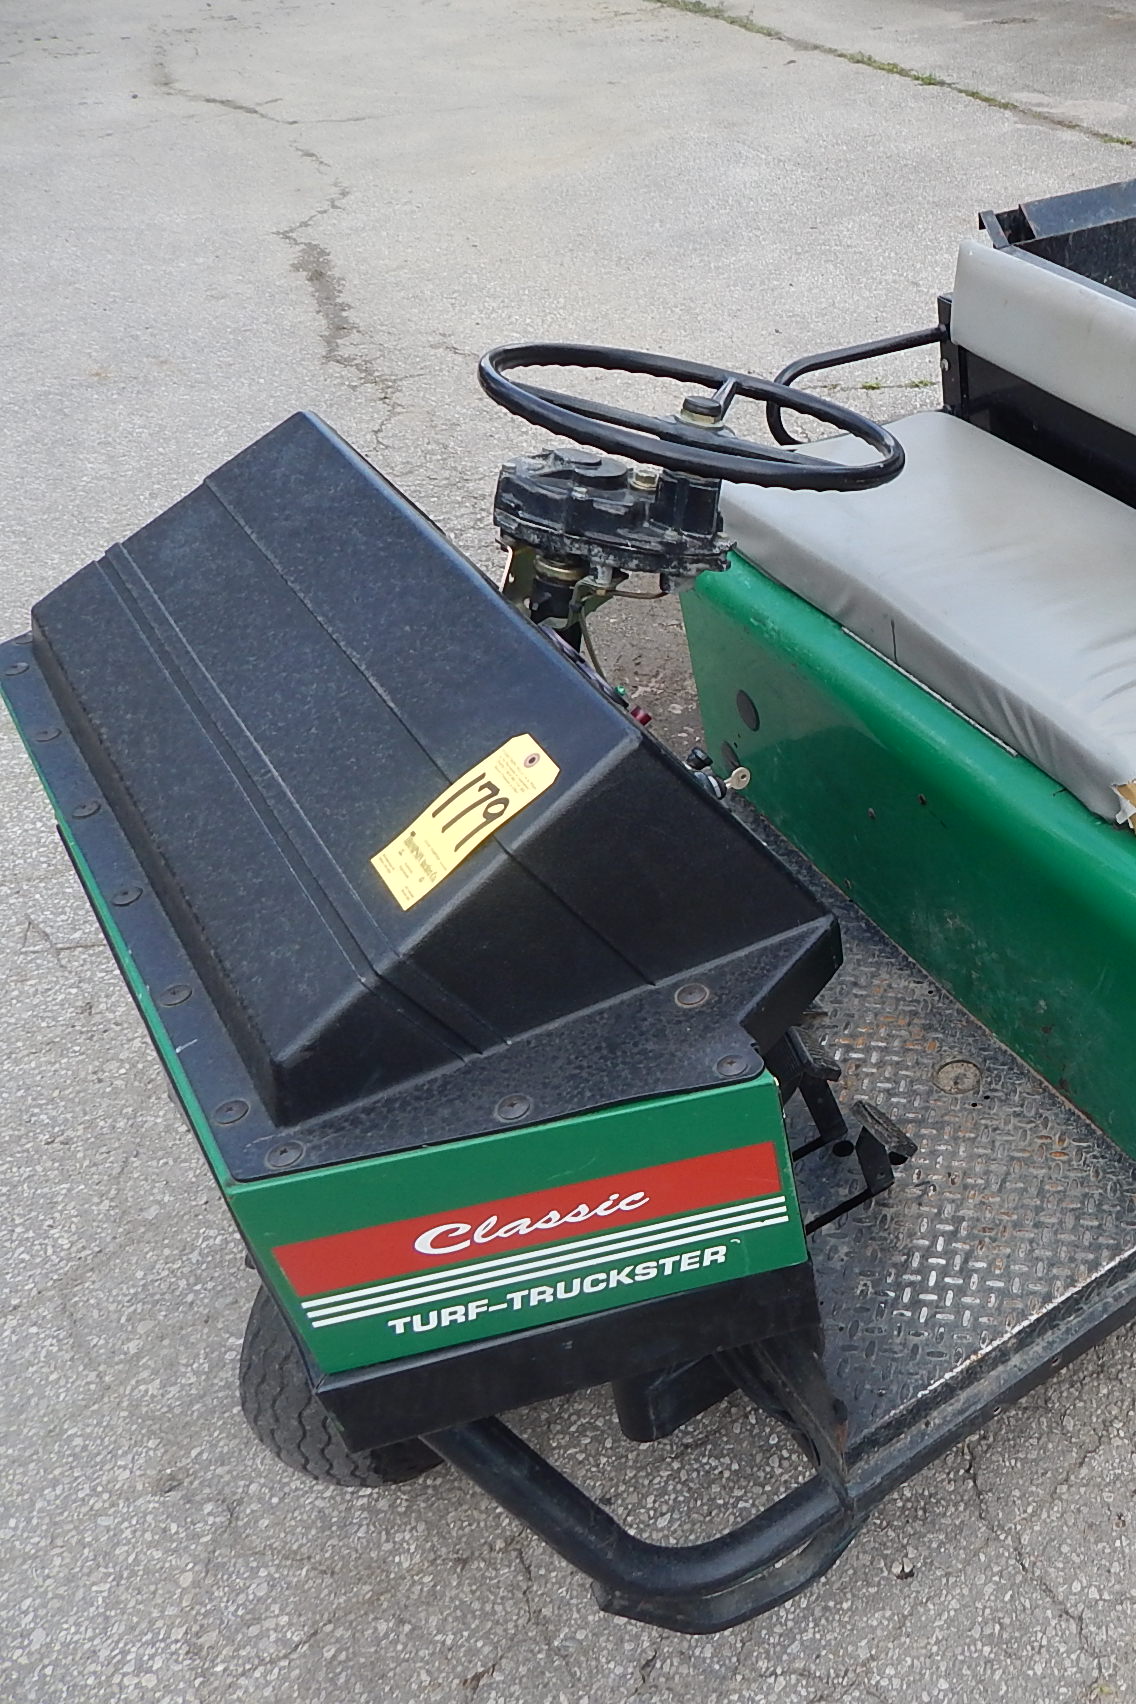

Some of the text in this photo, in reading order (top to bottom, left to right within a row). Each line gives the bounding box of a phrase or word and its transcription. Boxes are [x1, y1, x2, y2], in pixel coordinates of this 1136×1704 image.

[431, 772, 510, 852] 179
[413, 1191, 650, 1255] Classic
[388, 1244, 728, 1335] TURF-TRUCKSTER
